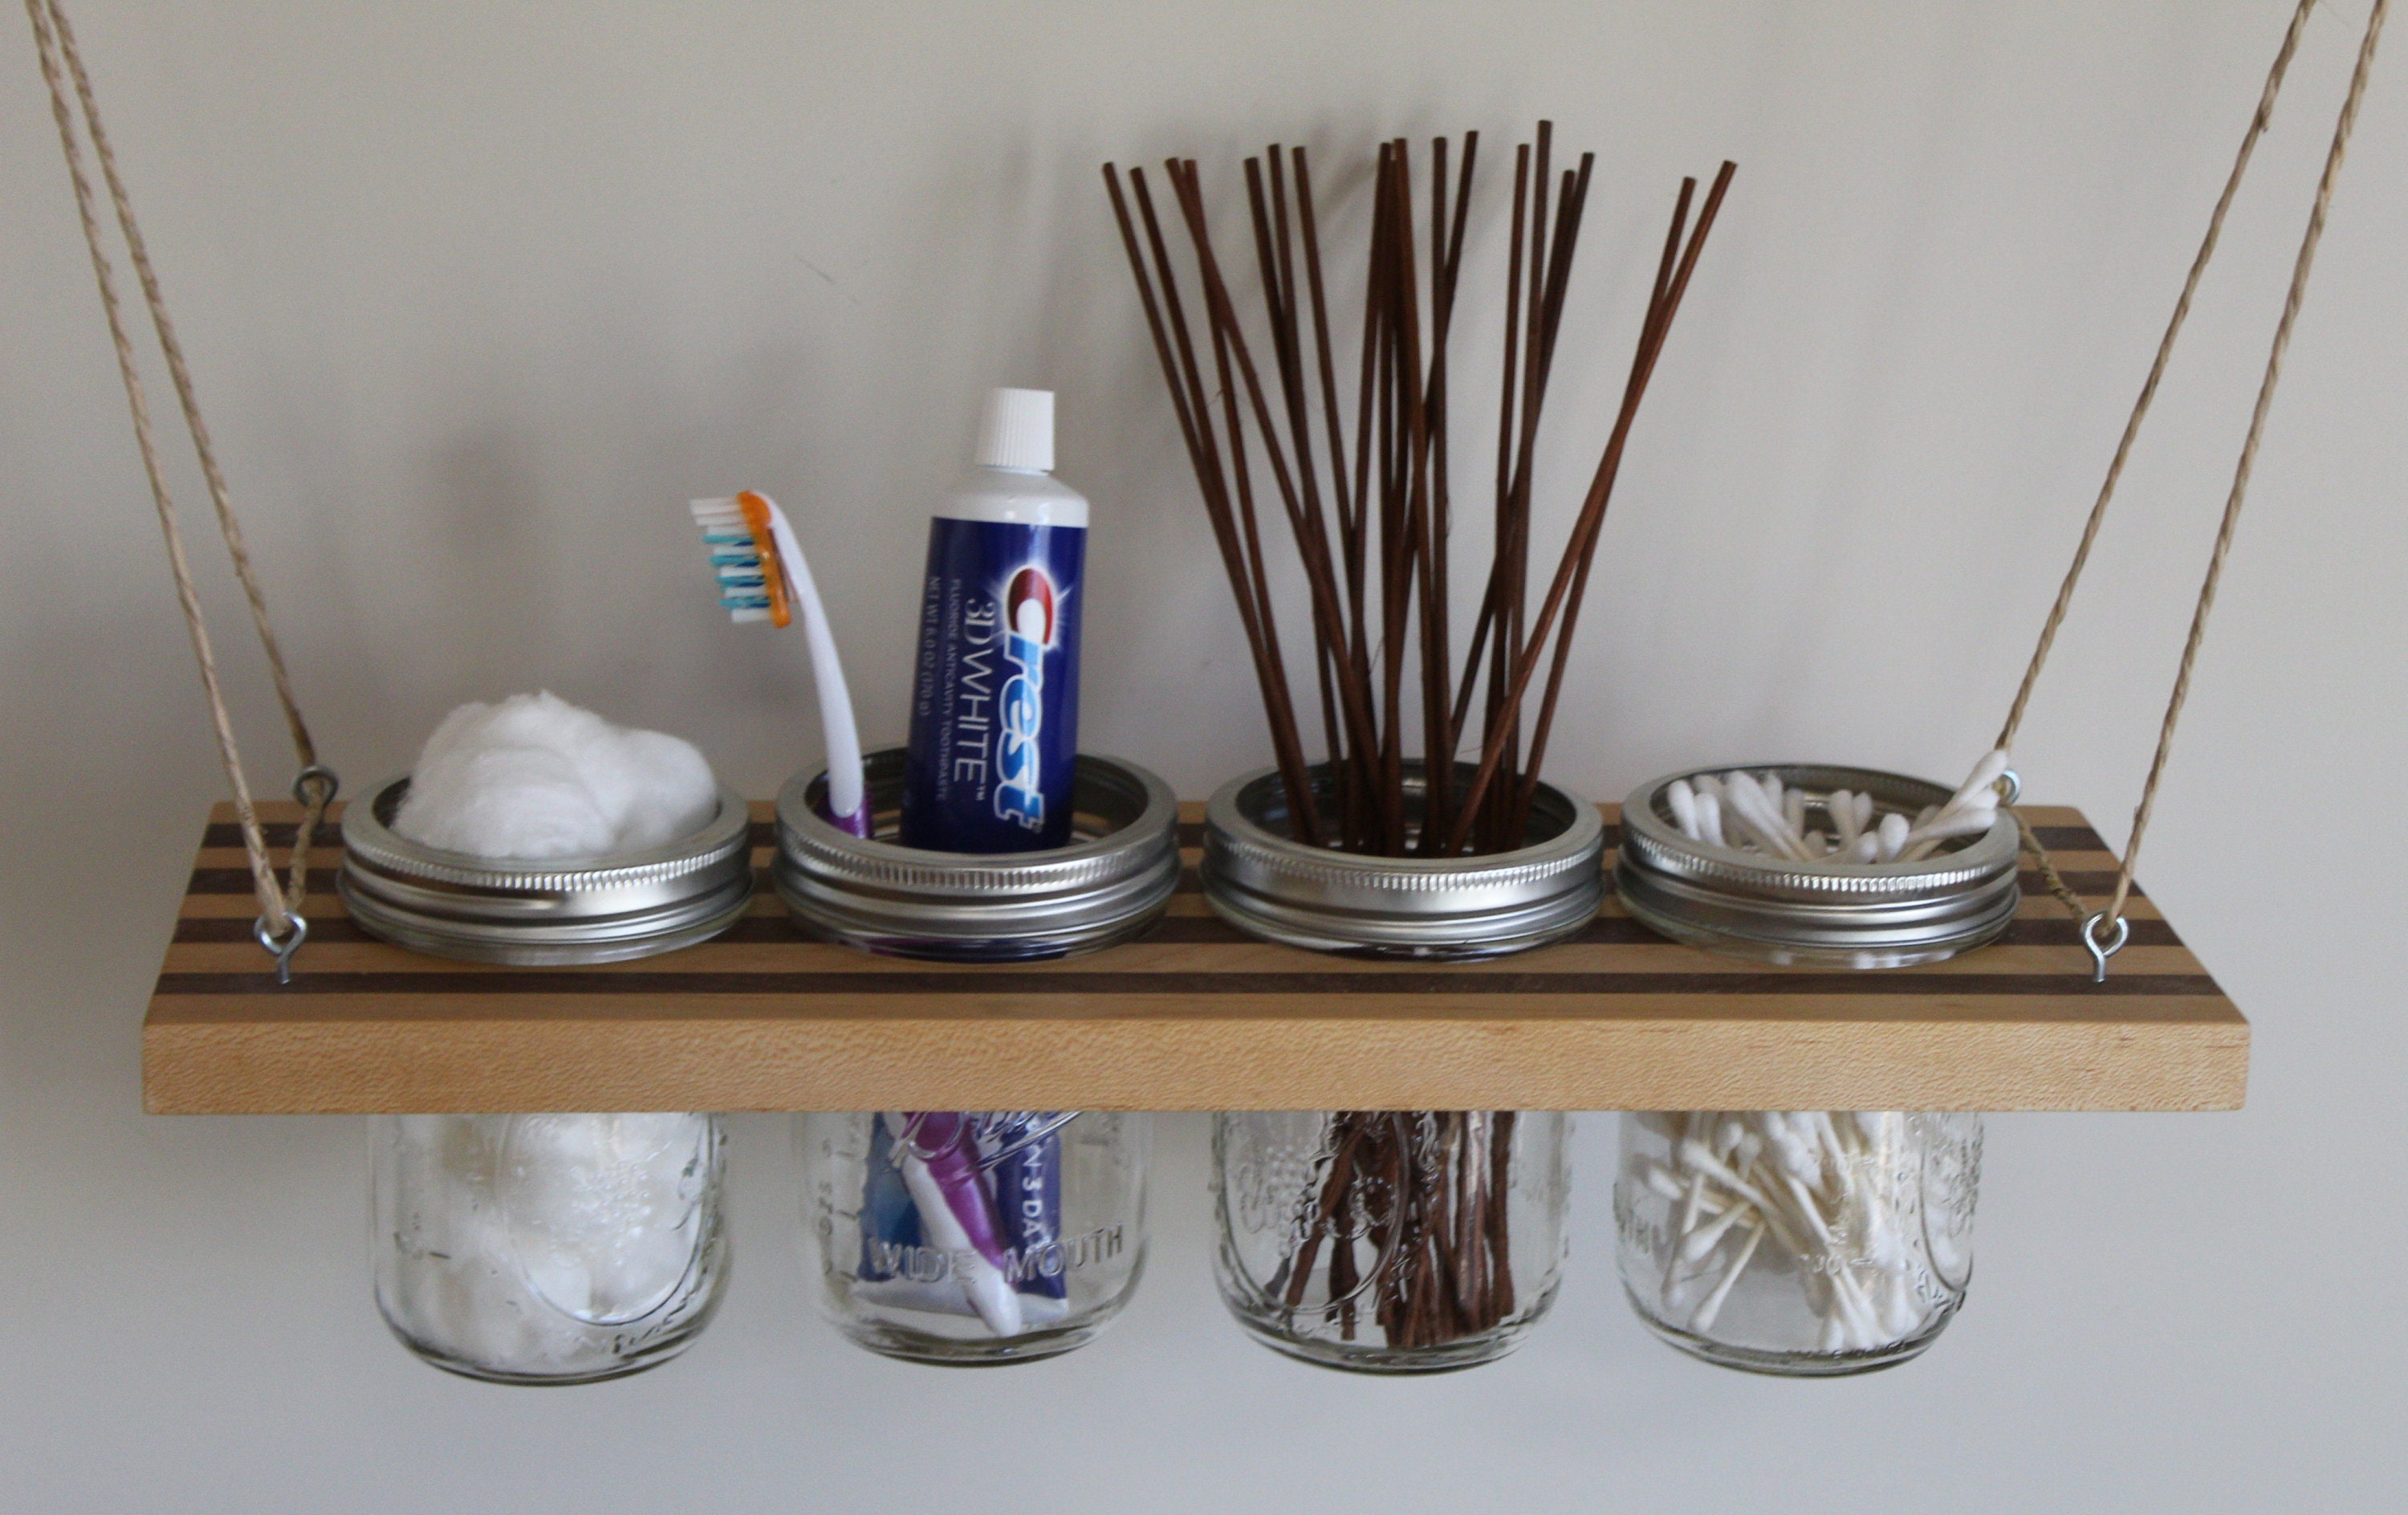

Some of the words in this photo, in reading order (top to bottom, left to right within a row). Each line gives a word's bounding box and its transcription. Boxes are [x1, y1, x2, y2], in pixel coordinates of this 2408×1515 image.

[928, 576, 942, 600] NET
[946, 578, 962, 641] FLUORIDE
[964, 597, 996, 646] 3D
[942, 642, 958, 717] ANTICAVITY
[994, 565, 1056, 829] Crest
[935, 719, 954, 802] TOOTHPASTE
[867, 1237, 976, 1284] WIDE
[1003, 1220, 1123, 1285] MOUTH
